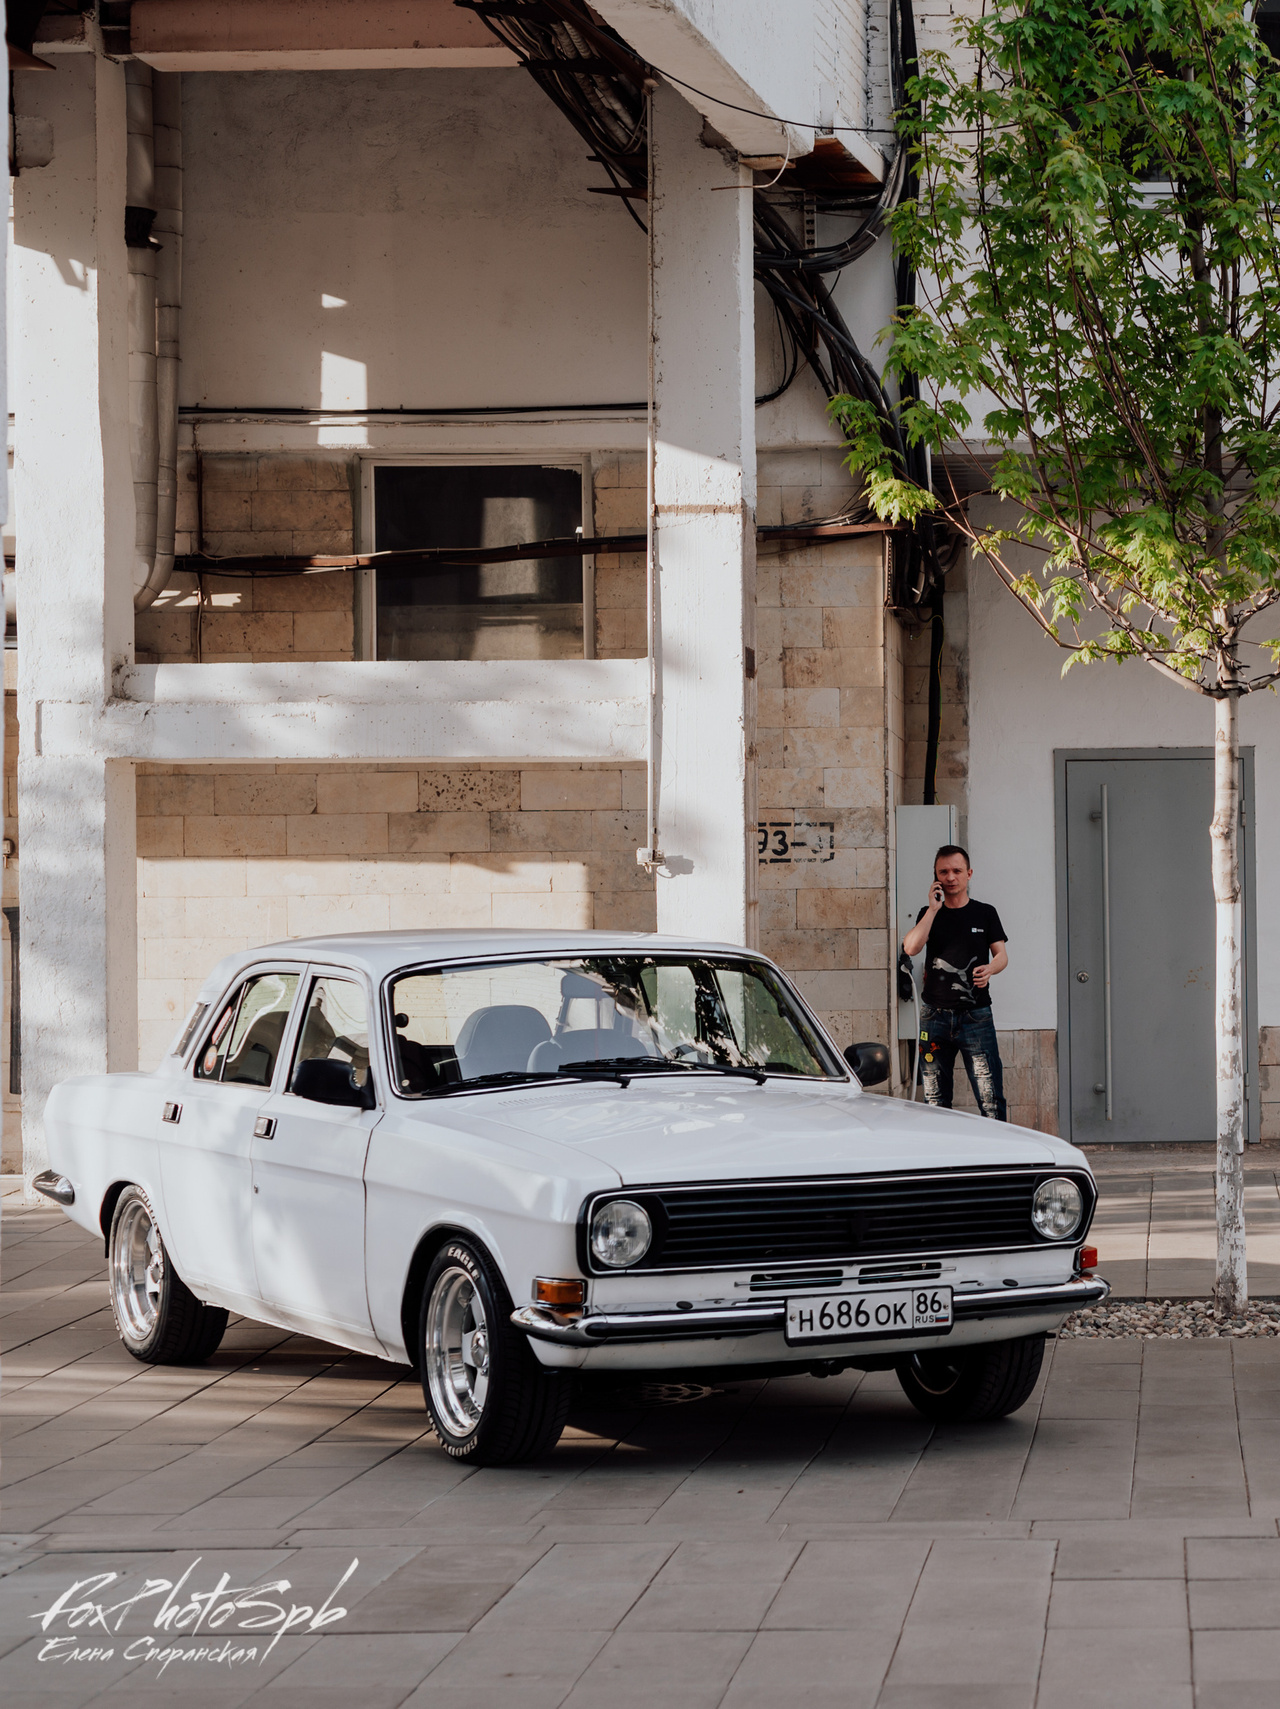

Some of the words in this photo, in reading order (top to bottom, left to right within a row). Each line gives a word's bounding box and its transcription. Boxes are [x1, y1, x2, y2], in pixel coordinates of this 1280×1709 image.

[447, 1246, 480, 1281] EAGLE
[799, 1299, 907, 1332] Н686ОК
[916, 1291, 942, 1315] 86
[915, 1314, 935, 1324] RUS
